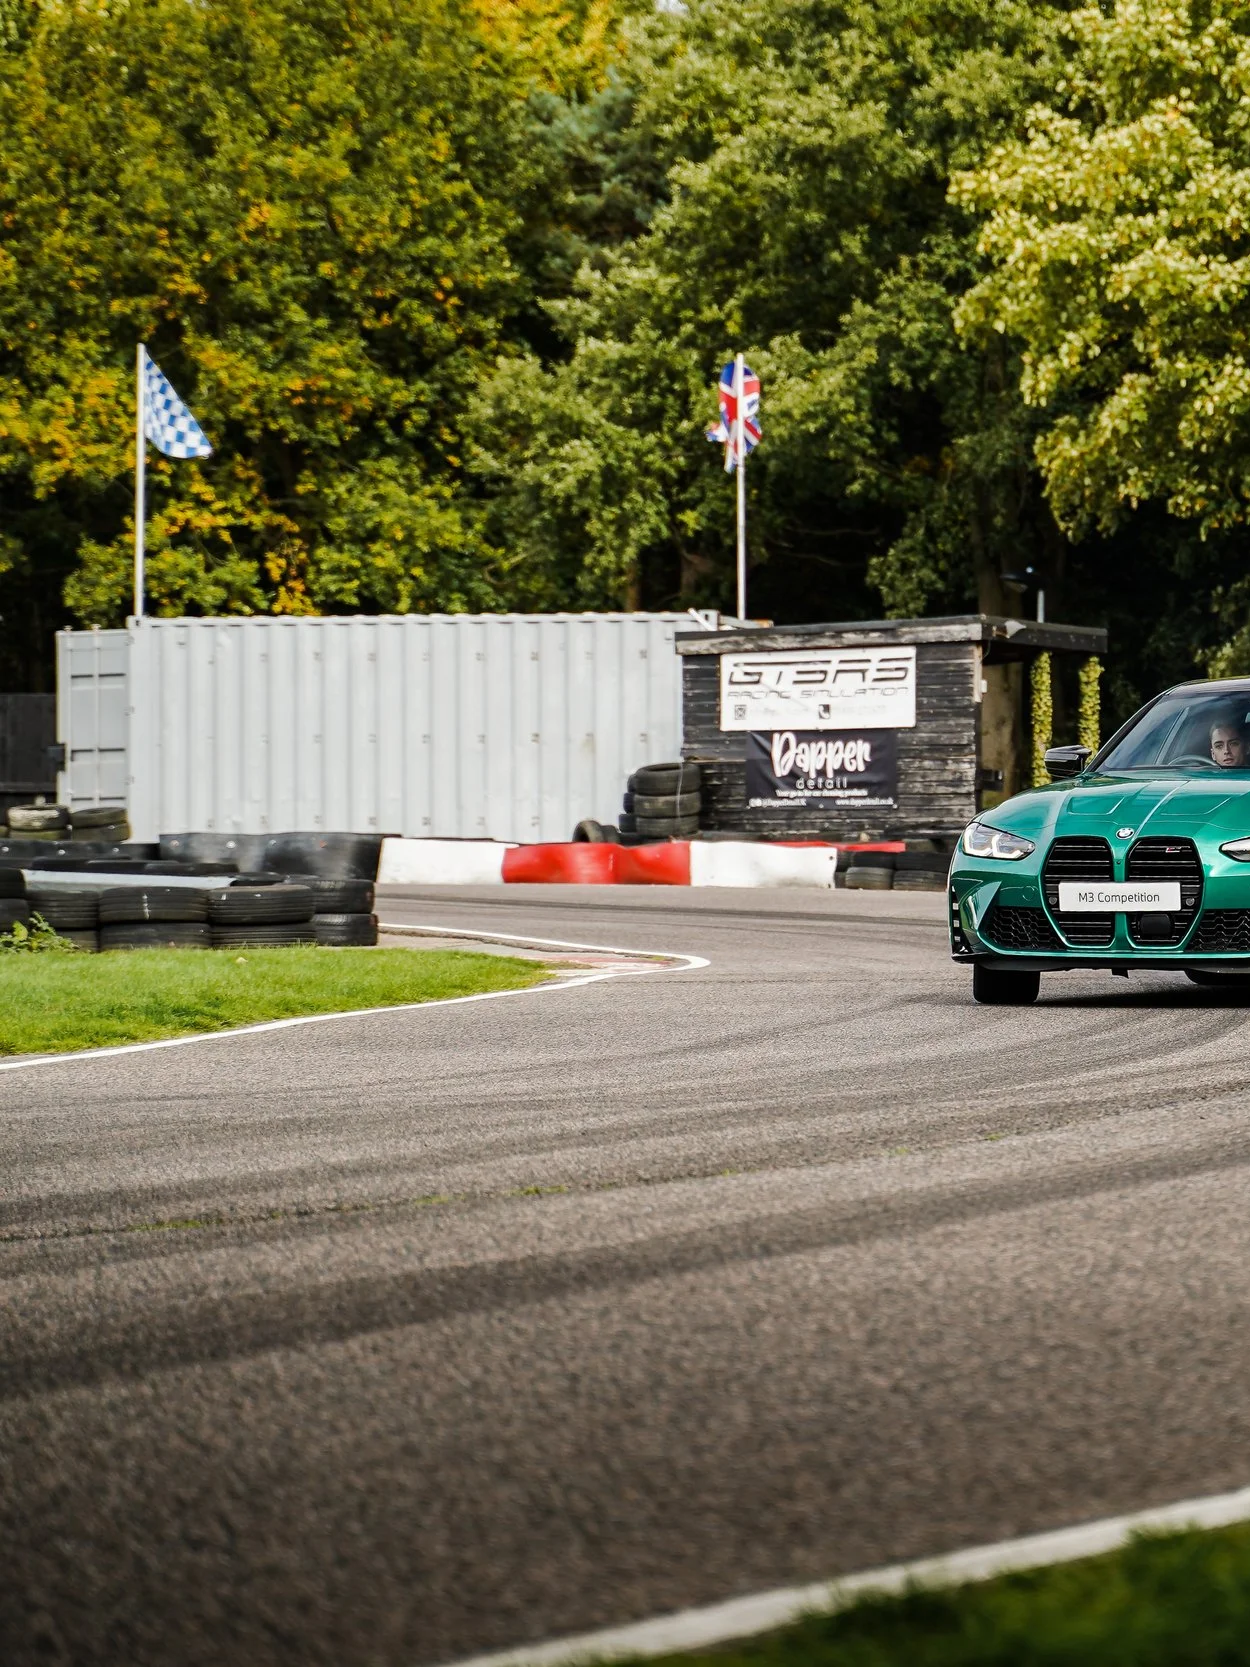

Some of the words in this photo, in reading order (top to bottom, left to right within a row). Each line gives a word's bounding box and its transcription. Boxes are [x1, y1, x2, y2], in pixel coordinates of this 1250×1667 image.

[771, 731, 872, 778] Dapper
[796, 777, 847, 789] detail
[1078, 892, 1095, 903] M3
[1097, 892, 1160, 904] Competition
